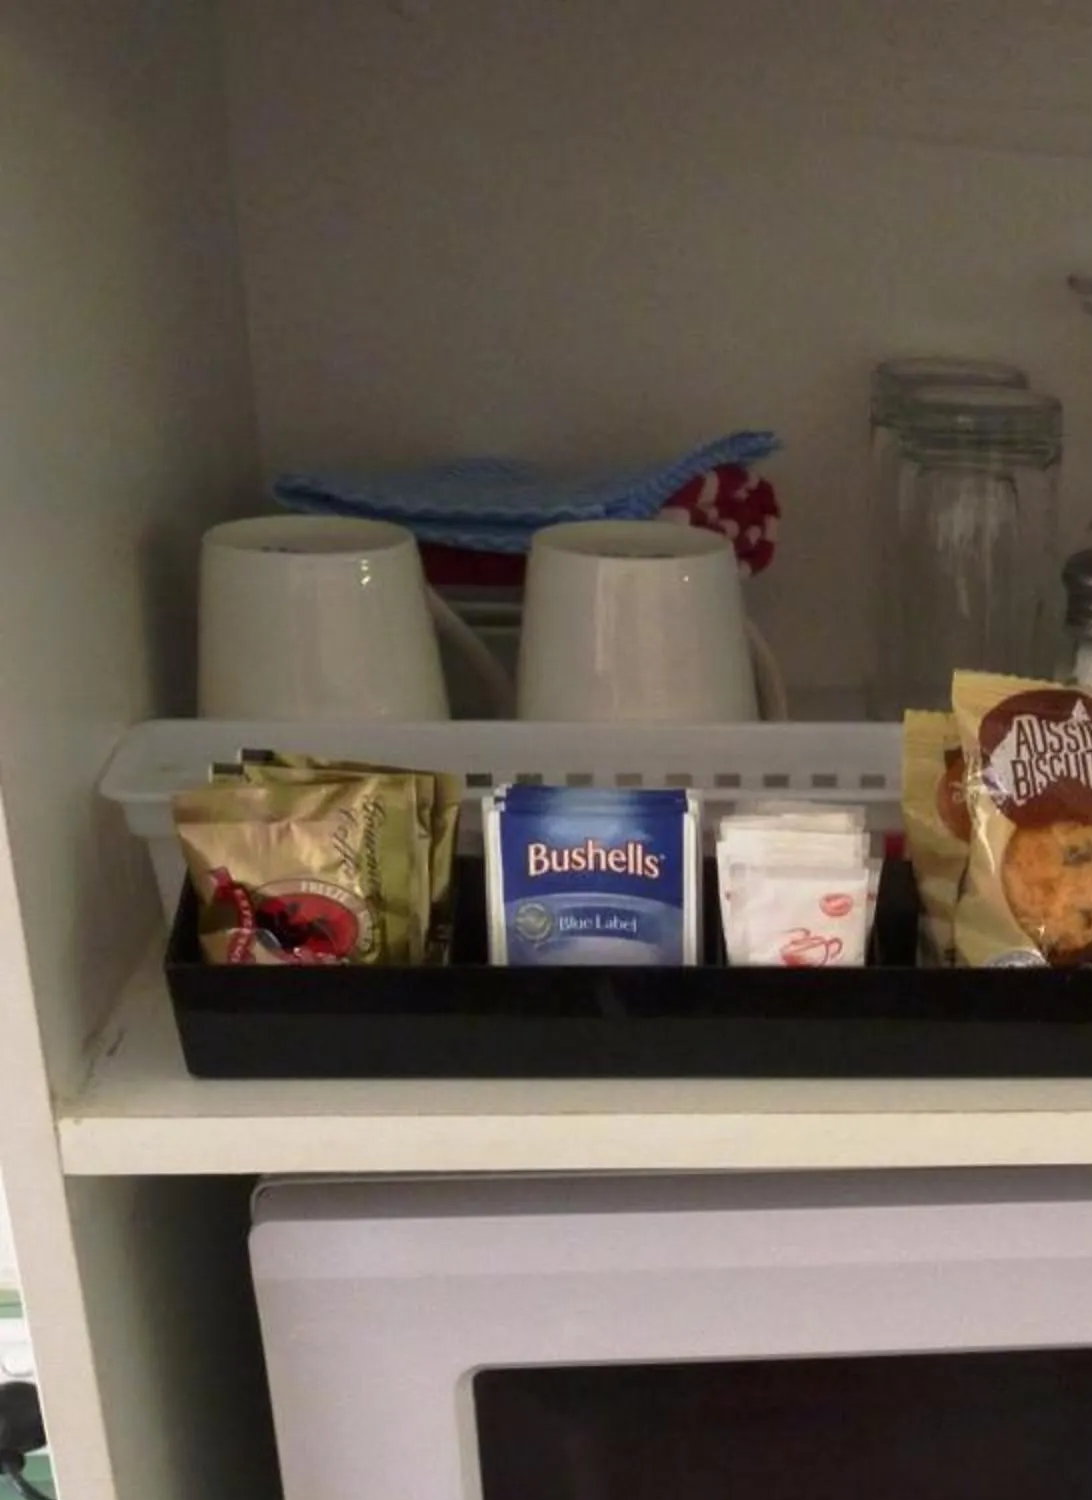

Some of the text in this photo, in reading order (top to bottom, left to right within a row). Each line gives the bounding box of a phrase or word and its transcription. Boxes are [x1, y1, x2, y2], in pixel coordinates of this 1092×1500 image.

[527, 839, 661, 880] Bushells
[558, 912, 638, 933] Blue Label
